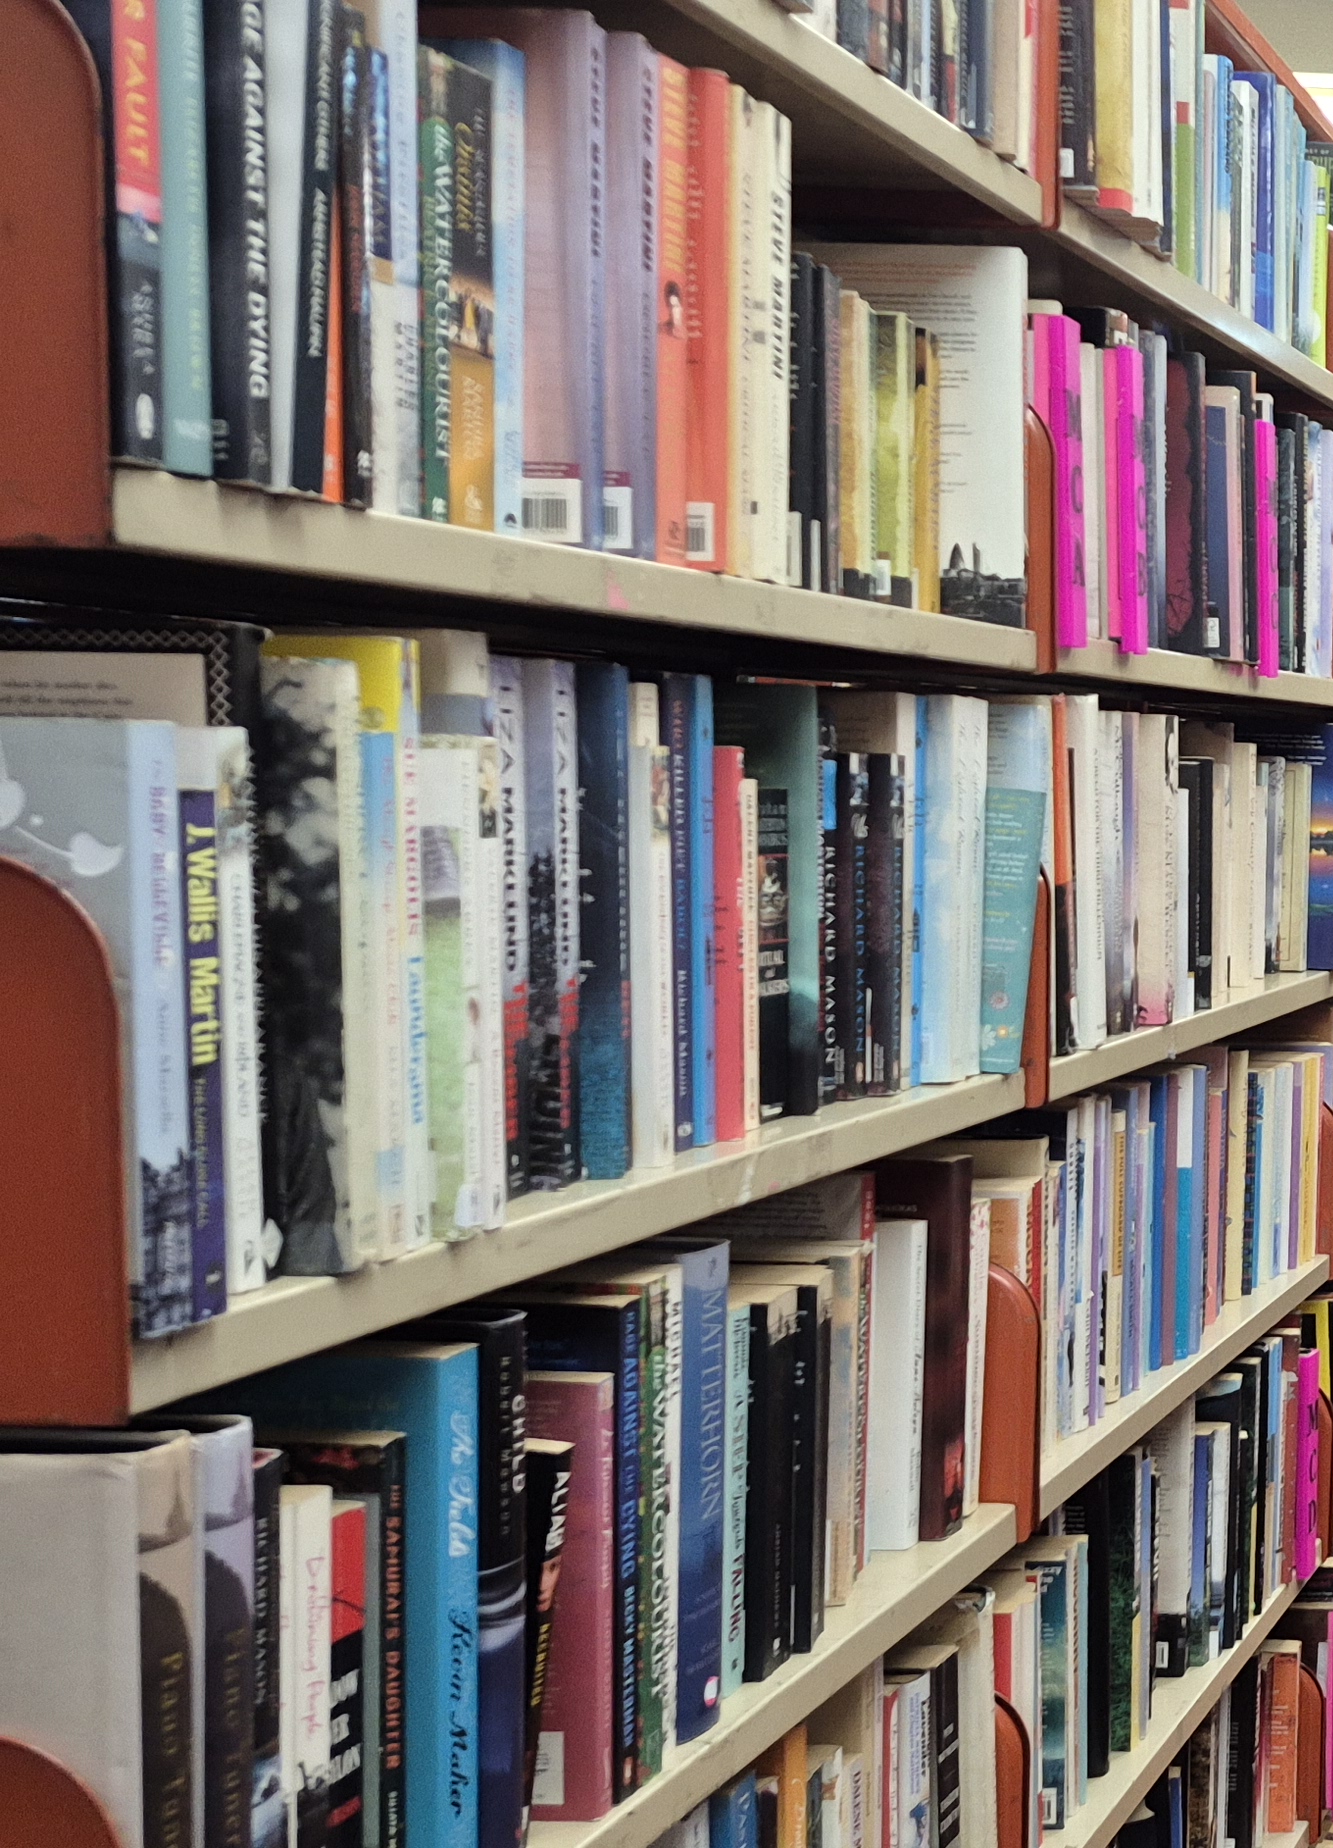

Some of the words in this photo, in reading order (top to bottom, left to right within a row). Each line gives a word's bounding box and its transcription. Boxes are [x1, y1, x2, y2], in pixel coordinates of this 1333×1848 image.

[123, 37, 151, 167] FAULT
[242, 55, 267, 208] AGAINST
[245, 219, 269, 284] THE
[664, 159, 686, 274] MARTINI
[770, 191, 784, 267] STEVE
[247, 291, 270, 398] DYING
[433, 158, 452, 465] WATERCOLOURIST
[771, 277, 783, 380] MARTINI
[403, 737, 418, 787] SUE
[185, 822, 218, 845] J.
[405, 796, 420, 938] MARGOLIS
[502, 787, 516, 972] MARKLUND
[557, 787, 571, 967] MARKLUND
[186, 849, 219, 944] Wallis
[823, 847, 836, 962] RICHARD
[854, 844, 866, 956] RICHARD
[189, 956, 220, 1067] Martin
[407, 955, 426, 1125] Launderama
[824, 974, 837, 1064] MASON
[854, 967, 866, 1052] MASON
[511, 1394, 527, 1494] CHILD
[620, 1357, 640, 1459] AGAINST
[698, 1288, 724, 1521] MATTERHORN
[385, 1516, 401, 1640] SAMURAI'S
[620, 1500, 640, 1580] DYING
[648, 1376, 665, 1697] WATERCOLOURIST
[622, 1585, 636, 1635] BECKY
[728, 1553, 745, 1642] FALLING
[254, 1628, 268, 1705] MASON
[446, 1608, 473, 1703] Kevin
[621, 1639, 636, 1748] MASTERMAN
[385, 1651, 401, 1770] DAUGHTER
[446, 1709, 470, 1821] Maher
